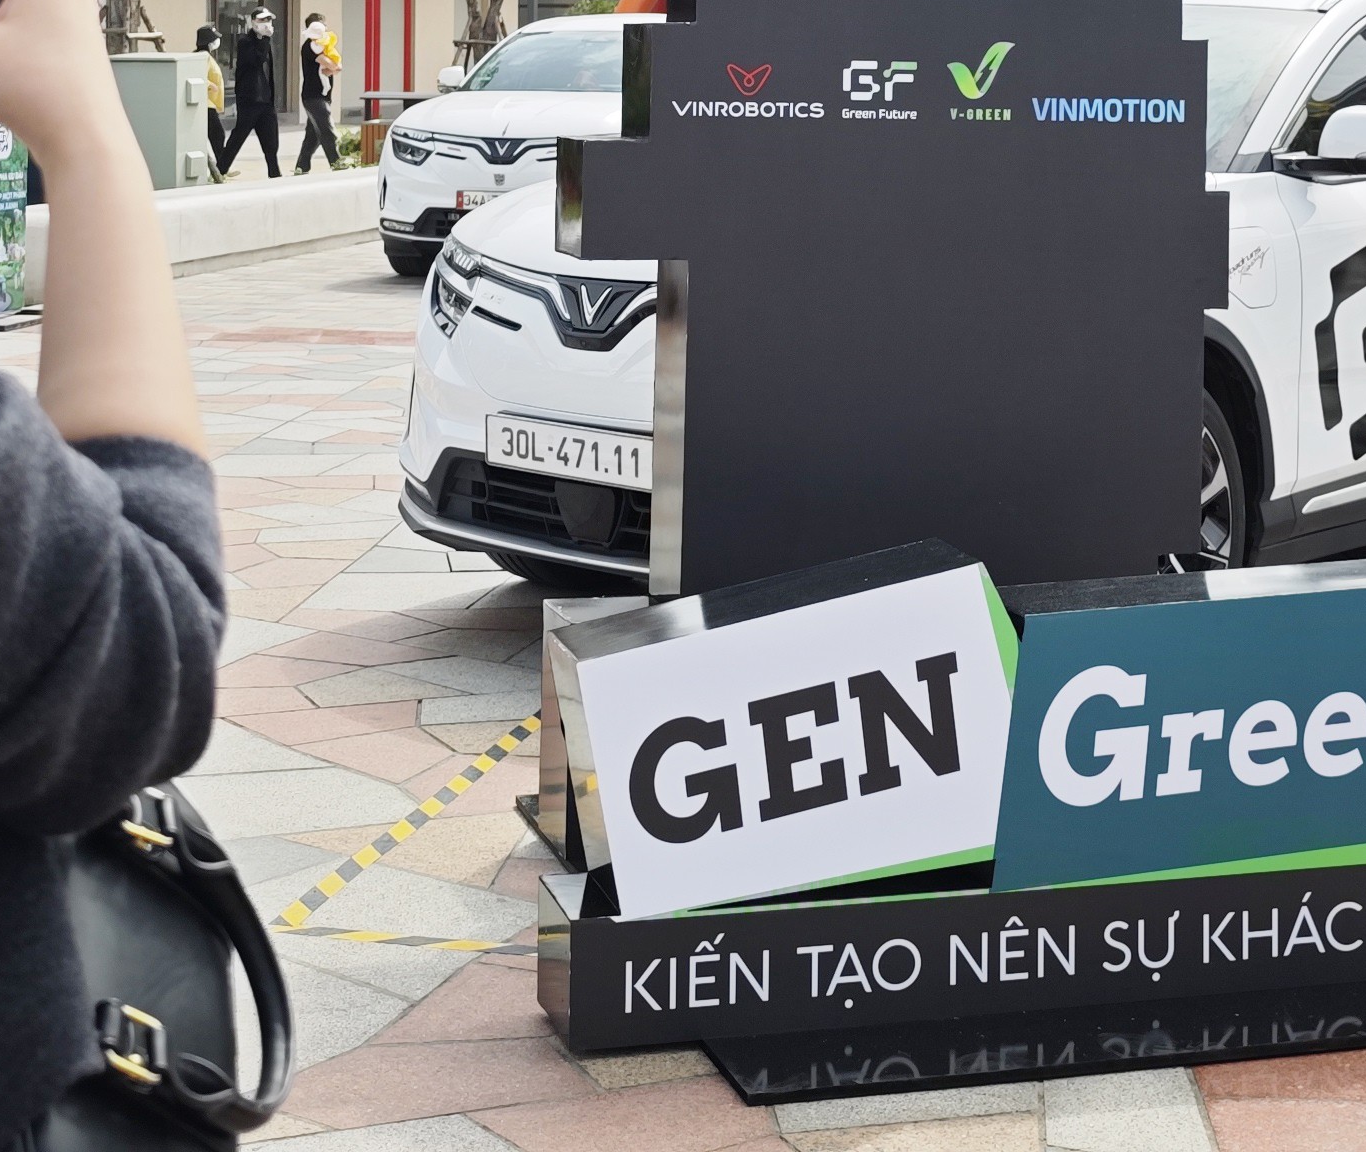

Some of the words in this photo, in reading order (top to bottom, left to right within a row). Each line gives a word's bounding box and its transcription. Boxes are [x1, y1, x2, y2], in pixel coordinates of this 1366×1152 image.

[672, 100, 825, 119] VINROBOTICS
[841, 108, 877, 120] Green
[878, 108, 918, 120] Future
[950, 108, 1011, 121] V-GREEN
[1031, 97, 1185, 123] VINMOTION
[501, 426, 639, 478] 30L-471.11
[629, 651, 961, 844] GEN
[624, 932, 770, 1013] KIẾN
[796, 938, 922, 1009] TẠO
[948, 915, 1076, 986] NÊN
[1102, 910, 1180, 982] SỰ
[1202, 891, 1364, 965] KHÁC
